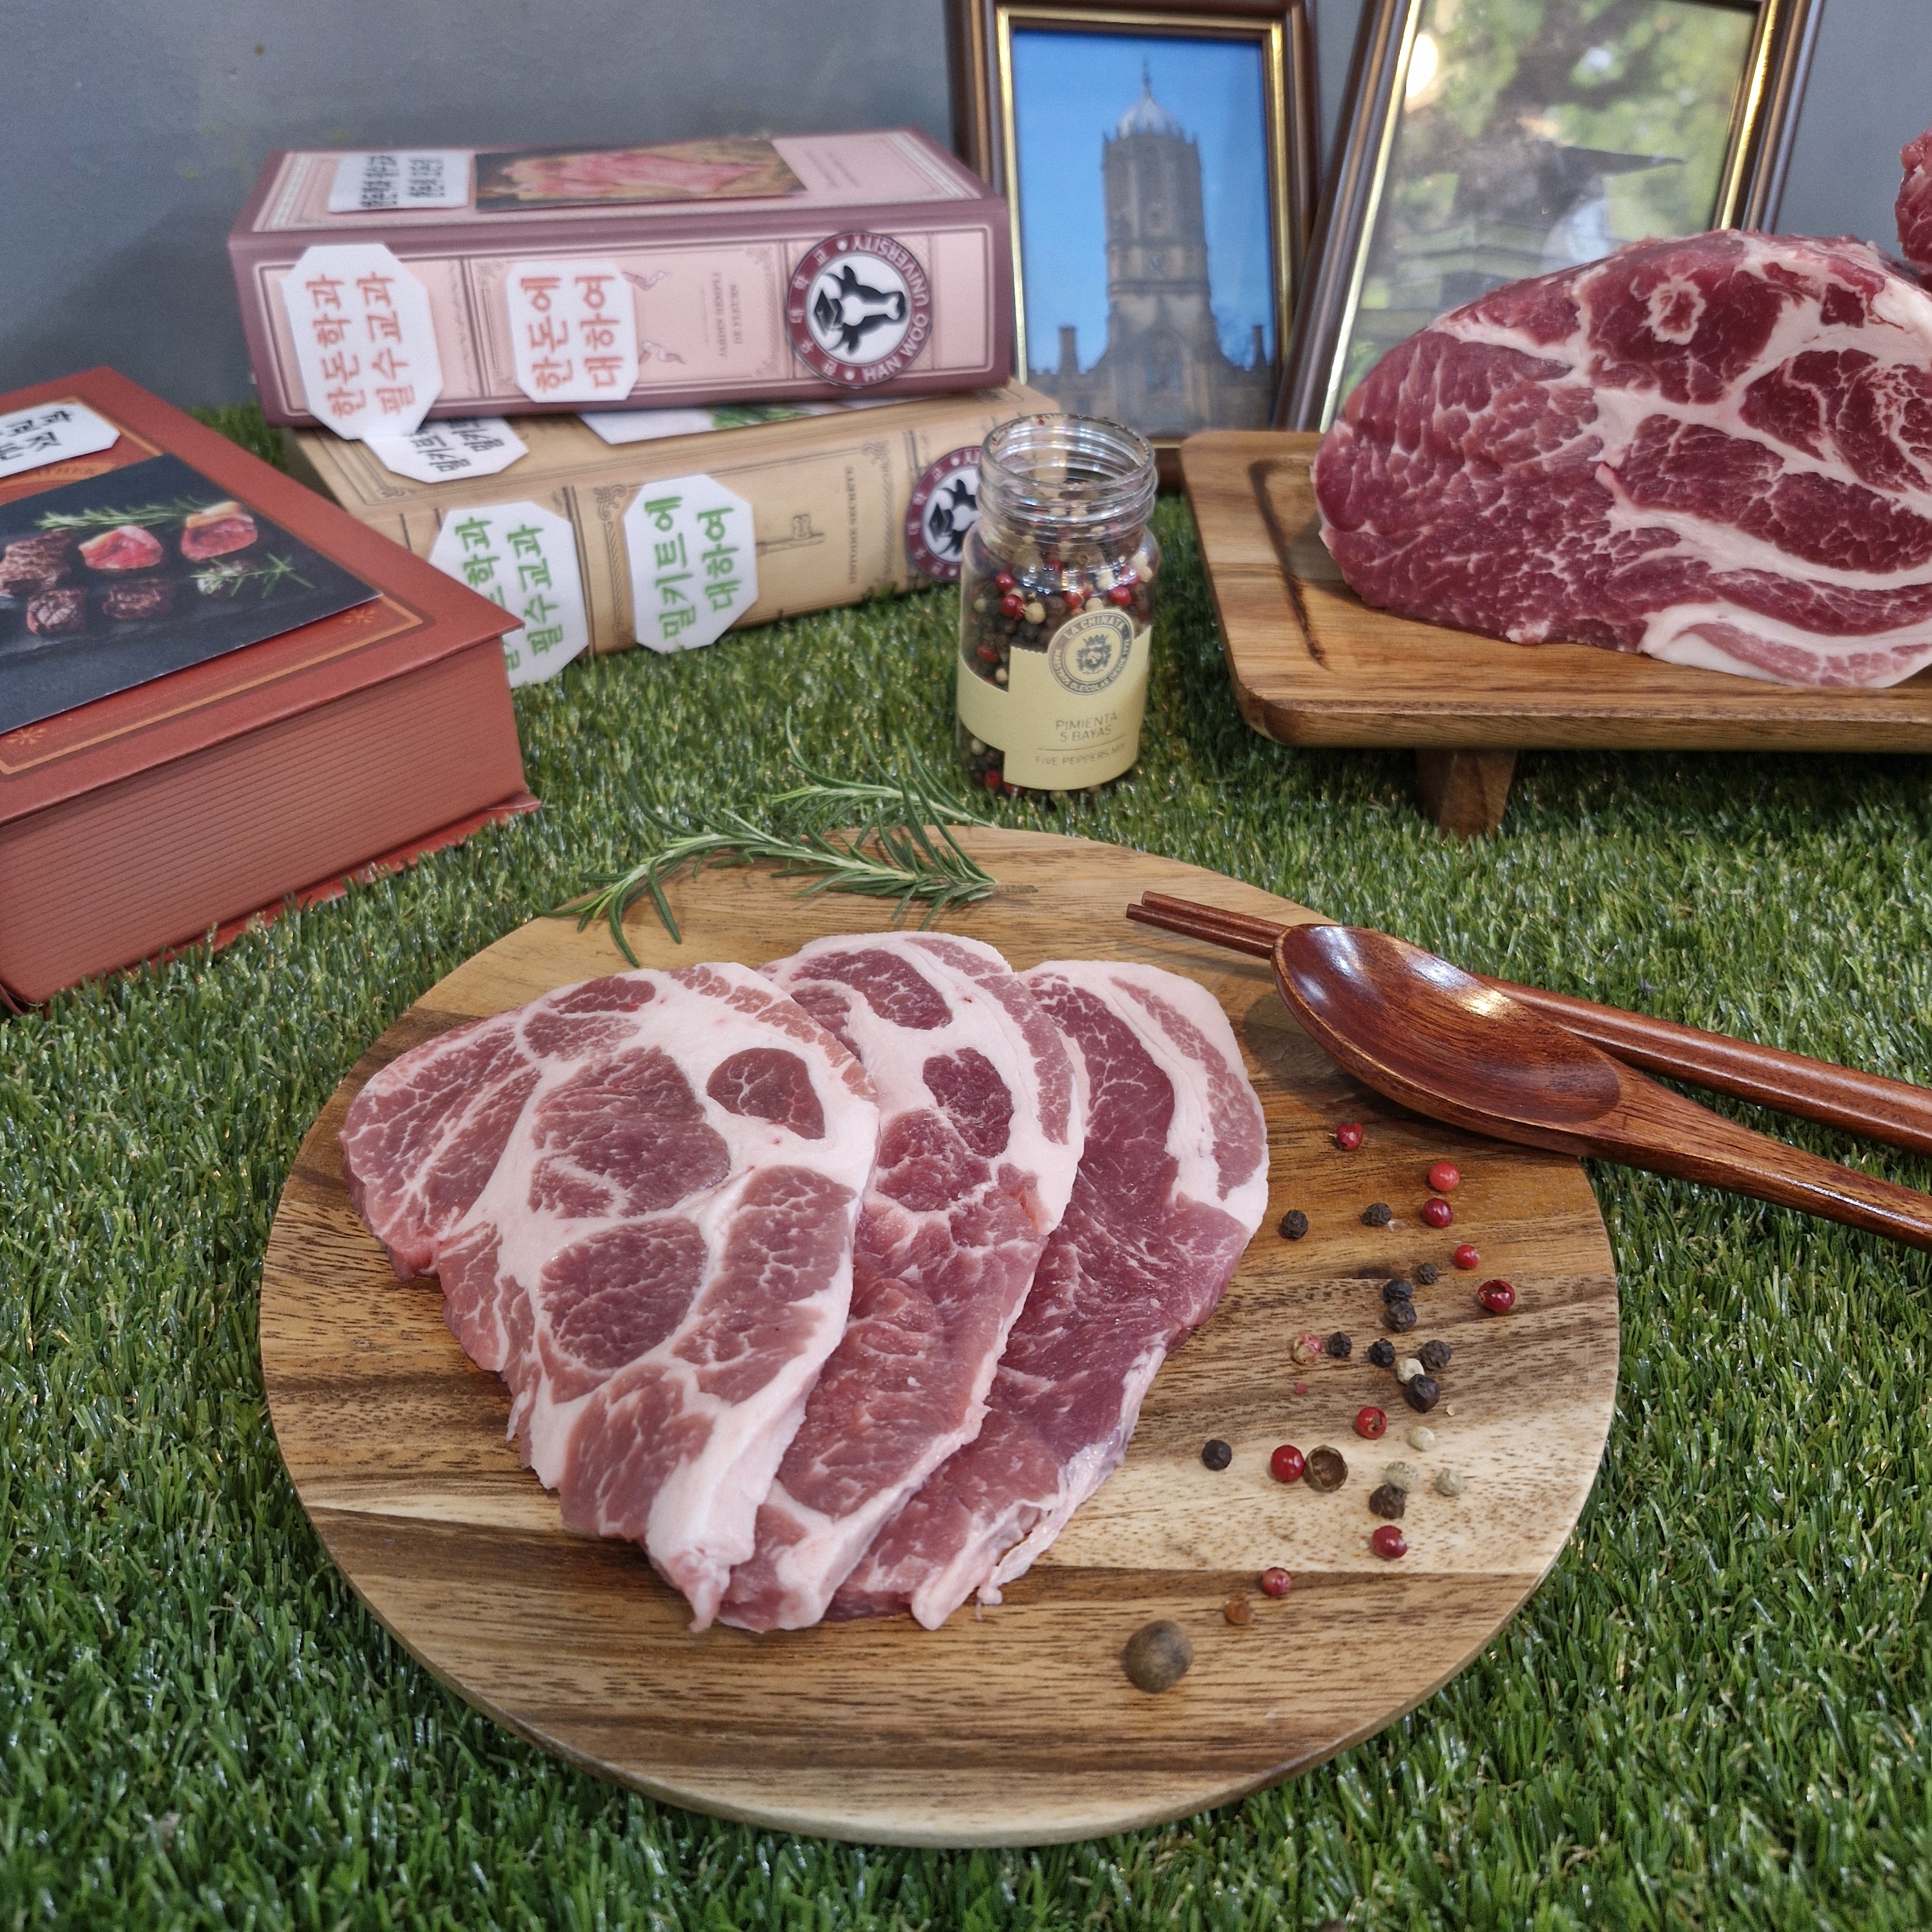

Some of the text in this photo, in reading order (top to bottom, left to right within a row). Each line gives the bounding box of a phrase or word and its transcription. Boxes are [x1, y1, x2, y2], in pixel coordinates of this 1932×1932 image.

[306, 273, 366, 418] 한돈학과
[357, 271, 415, 415] 필수교과
[520, 277, 573, 393] 한돈에
[575, 276, 623, 389] 대하여
[852, 234, 929, 382] HAN WOO UNIVERSITY
[0, 410, 75, 438] 교과
[507, 524, 564, 657] 필수교과
[644, 497, 695, 640] 밀키트에
[697, 508, 742, 612] 대하여
[1063, 615, 1125, 640] LA CHINATA
[1036, 755, 1058, 766] FIVE
[1056, 712, 1116, 730] PIMIENTA
[1060, 724, 1111, 743] 5 BAYAS
